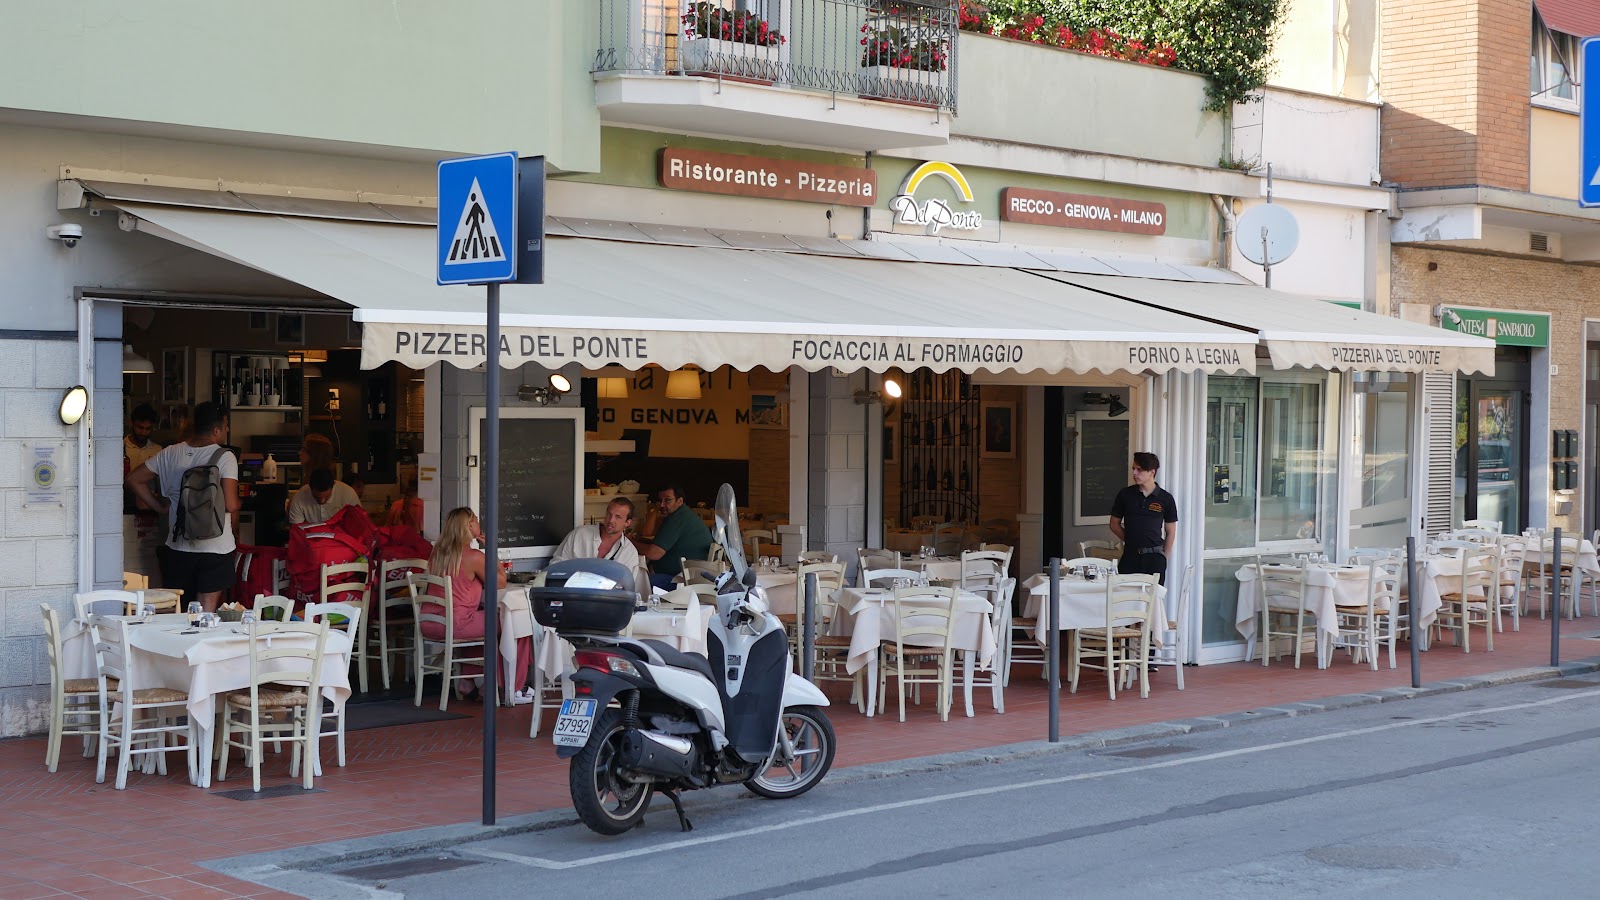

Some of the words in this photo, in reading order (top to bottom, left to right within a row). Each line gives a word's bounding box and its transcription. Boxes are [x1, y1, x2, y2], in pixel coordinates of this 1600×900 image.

[670, 158, 777, 187] Ristorante
[798, 172, 872, 197] Pizzeria
[897, 196, 929, 222] Del
[931, 199, 982, 233] Ponte
[1011, 197, 1054, 215] RECCO
[1064, 203, 1111, 221] GENOVA
[1121, 210, 1162, 226] MILANO
[1498, 321, 1536, 338] SANPAOLO
[395, 331, 512, 356] PIZZERA
[520, 335, 565, 357] DEL
[572, 336, 648, 358] PONTE
[792, 340, 889, 361] FOCACCIA
[894, 343, 916, 362] AL
[921, 343, 1023, 363] FORMAGGIO
[1129, 346, 1180, 364] FORNO
[1185, 347, 1194, 364] A
[1197, 348, 1241, 365] LEGNA
[1332, 347, 1383, 364] PIZZERIA
[1385, 349, 1406, 364] DEL
[1408, 350, 1441, 365] PONTE
[631, 408, 719, 424] GENOVA
[296, 590, 314, 603] EAT
[570, 701, 583, 714] DY
[558, 717, 589, 734] 37992
